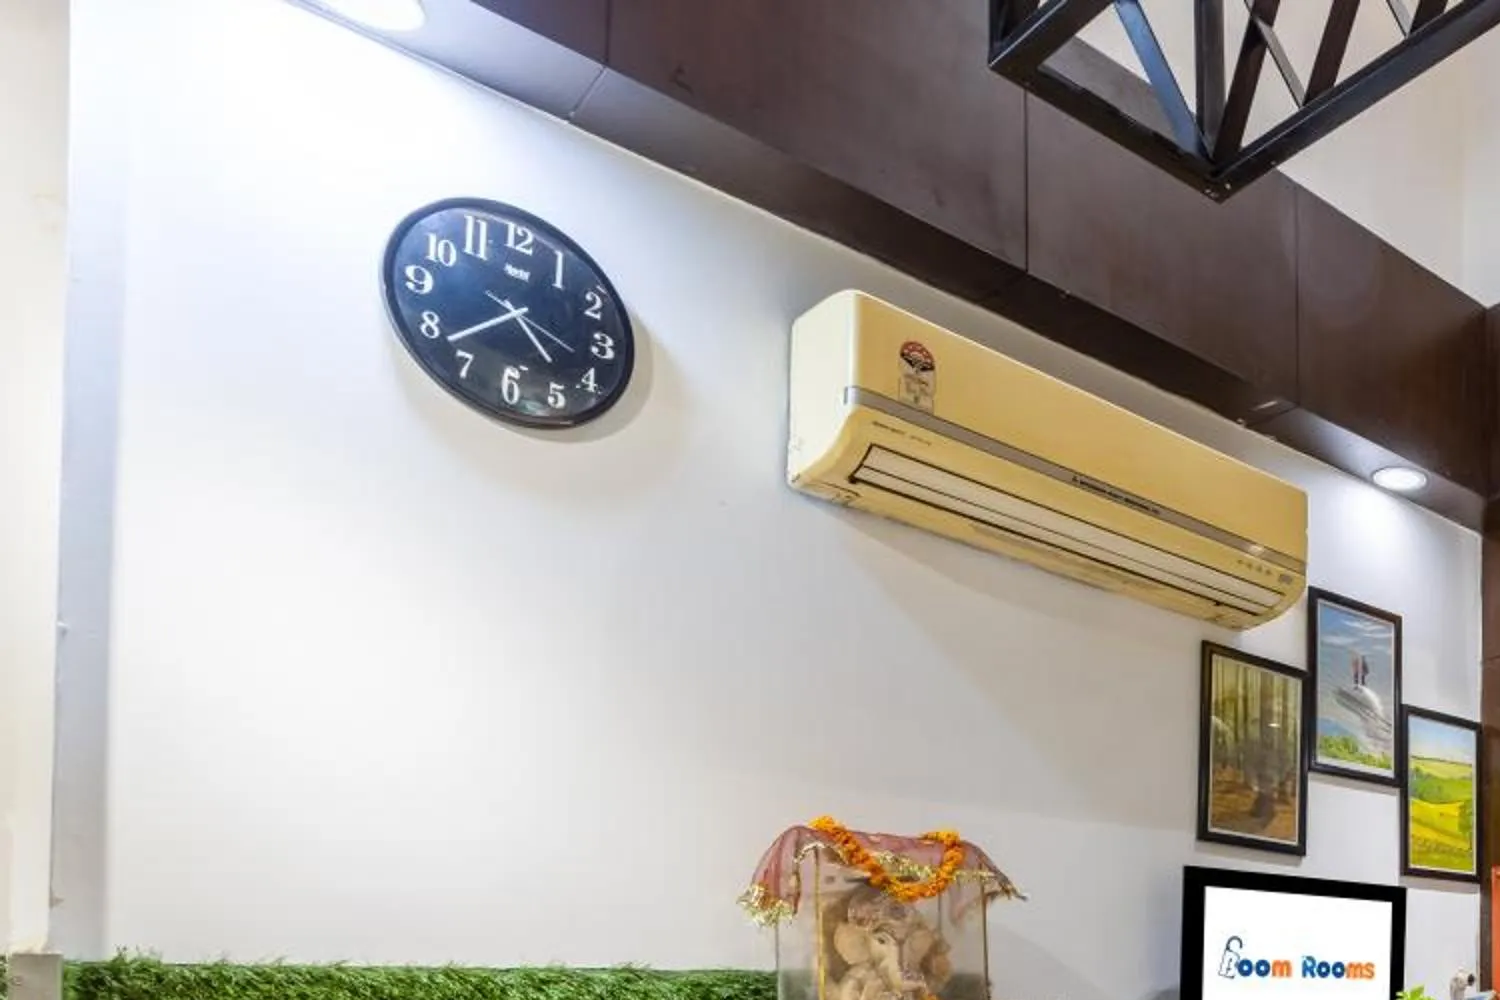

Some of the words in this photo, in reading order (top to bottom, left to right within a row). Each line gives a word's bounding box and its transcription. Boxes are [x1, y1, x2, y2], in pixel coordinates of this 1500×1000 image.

[426, 232, 457, 267] 10
[463, 215, 489, 261] 11
[504, 221, 534, 255] 12
[404, 264, 434, 295] 9
[552, 250, 565, 290] 1
[584, 290, 603, 320] 2
[420, 311, 440, 339] 8
[591, 332, 615, 360] 3
[455, 350, 474, 379] 7
[502, 366, 520, 405] 6
[548, 382, 566, 408] 5
[581, 367, 598, 393] 4
[1301, 955, 1376, 980] Rooms
